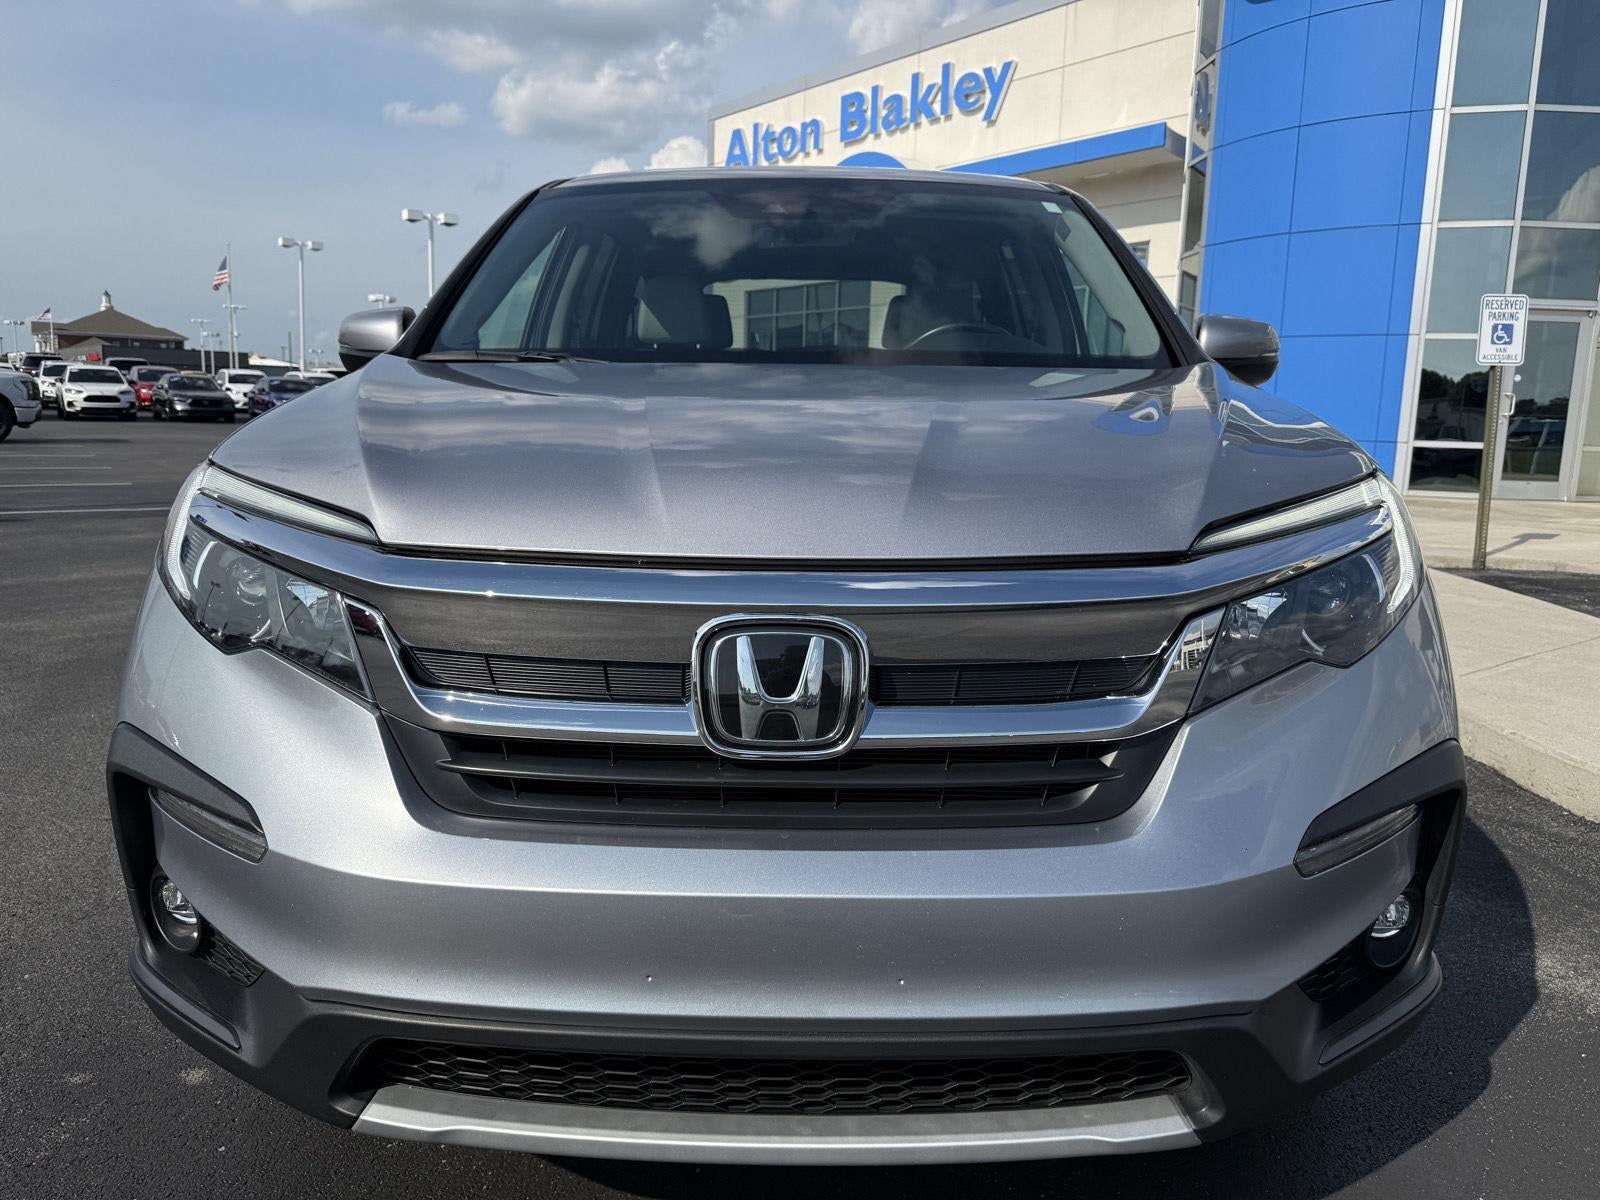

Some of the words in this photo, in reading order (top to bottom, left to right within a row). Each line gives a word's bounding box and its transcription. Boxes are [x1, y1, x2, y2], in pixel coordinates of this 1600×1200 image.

[724, 118, 822, 167] Alton
[839, 60, 1015, 142] Blakley
[1485, 299, 1524, 310] RESERVED
[1488, 311, 1519, 321] PARKING
[1482, 353, 1518, 361] ACCESSIBLE
